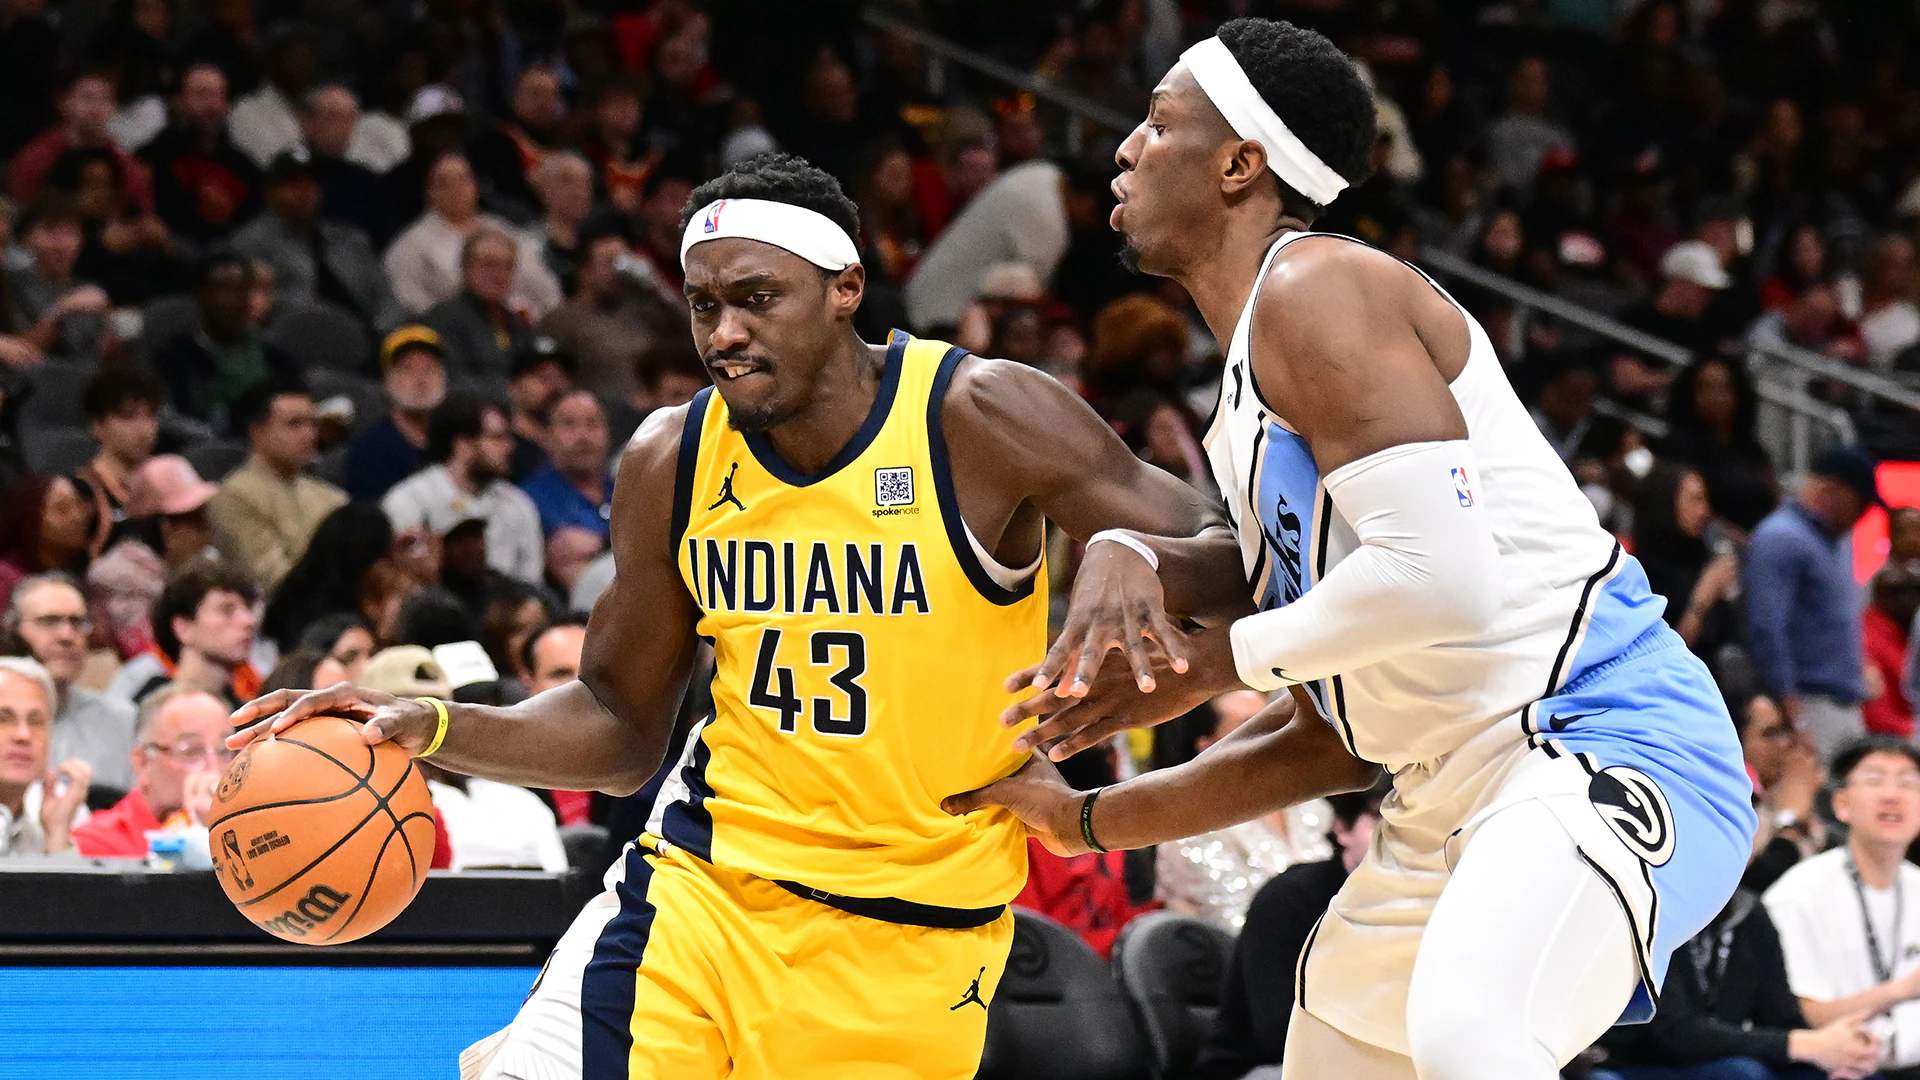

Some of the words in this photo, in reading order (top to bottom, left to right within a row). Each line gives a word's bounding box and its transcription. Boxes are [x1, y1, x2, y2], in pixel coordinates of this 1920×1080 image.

[872, 507, 919, 518] spokenote
[689, 537, 931, 616] INDIANA
[749, 627, 868, 738] 43
